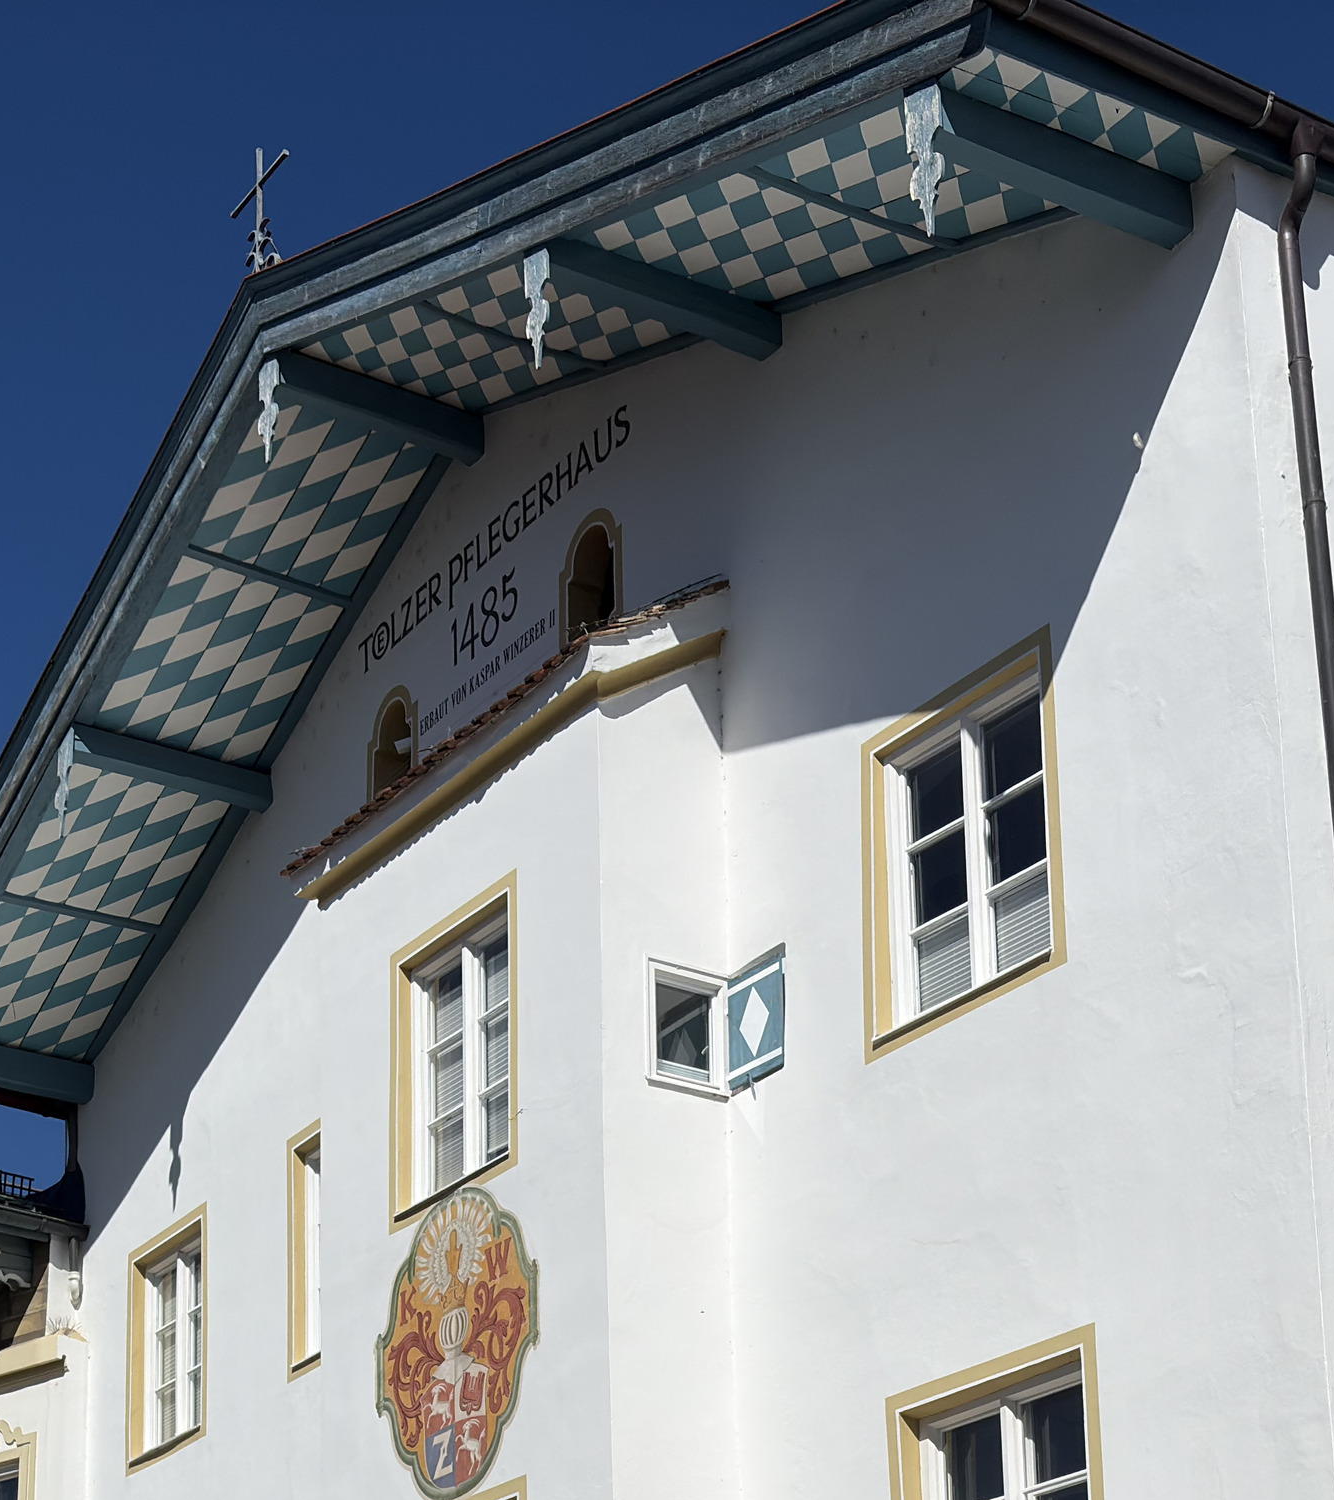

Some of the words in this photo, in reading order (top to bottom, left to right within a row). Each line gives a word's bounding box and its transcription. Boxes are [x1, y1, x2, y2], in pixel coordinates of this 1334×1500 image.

[448, 404, 631, 612] PFLEGERHAUS
[419, 698, 449, 736] ERBAUT
[451, 683, 467, 708] VON
[469, 655, 501, 695] KASPAR
[502, 618, 546, 665] WINZERER
[549, 608, 556, 629] II
[450, 566, 519, 666] 1485
